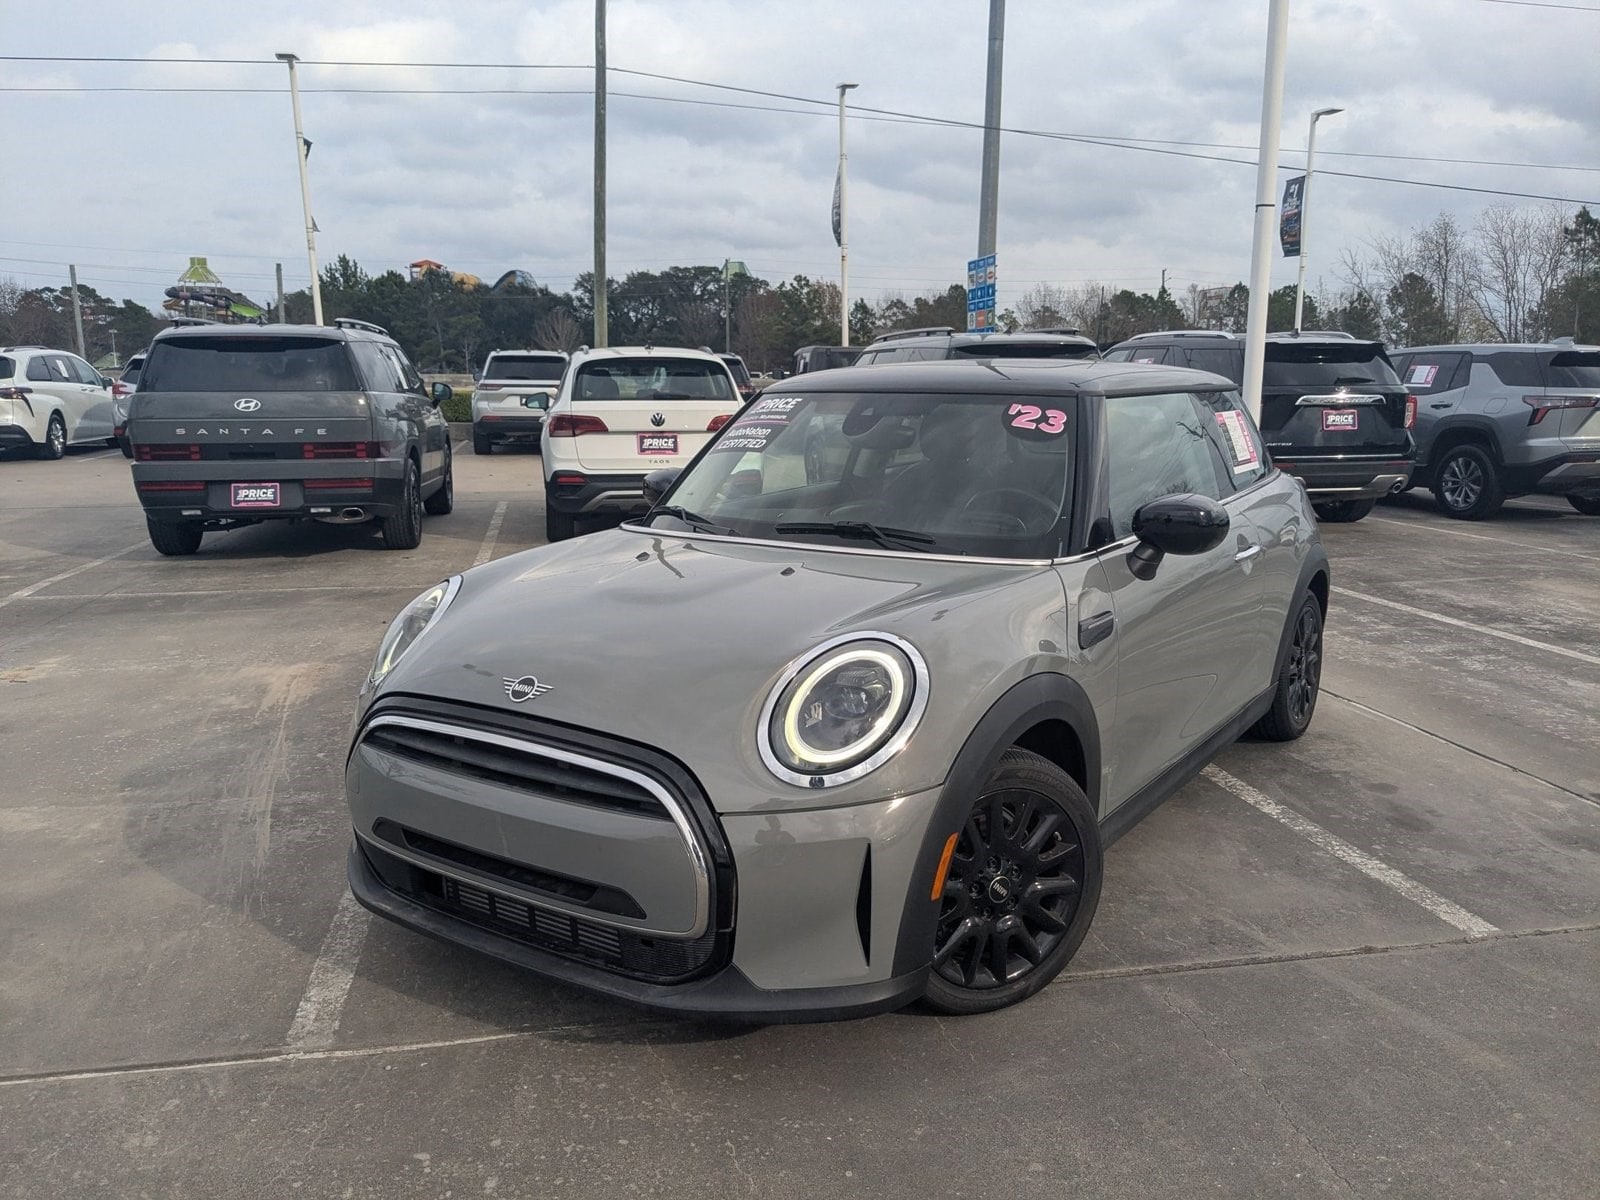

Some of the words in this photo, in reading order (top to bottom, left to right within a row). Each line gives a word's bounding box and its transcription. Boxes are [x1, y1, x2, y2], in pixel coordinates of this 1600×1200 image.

[1007, 403, 1067, 434] '23
[728, 426, 772, 437] AutoNation
[717, 439, 768, 450] CERTIFIED
[236, 488, 275, 498] 1PRICE
[513, 683, 534, 693] MINI
[992, 881, 1008, 897] MINI
